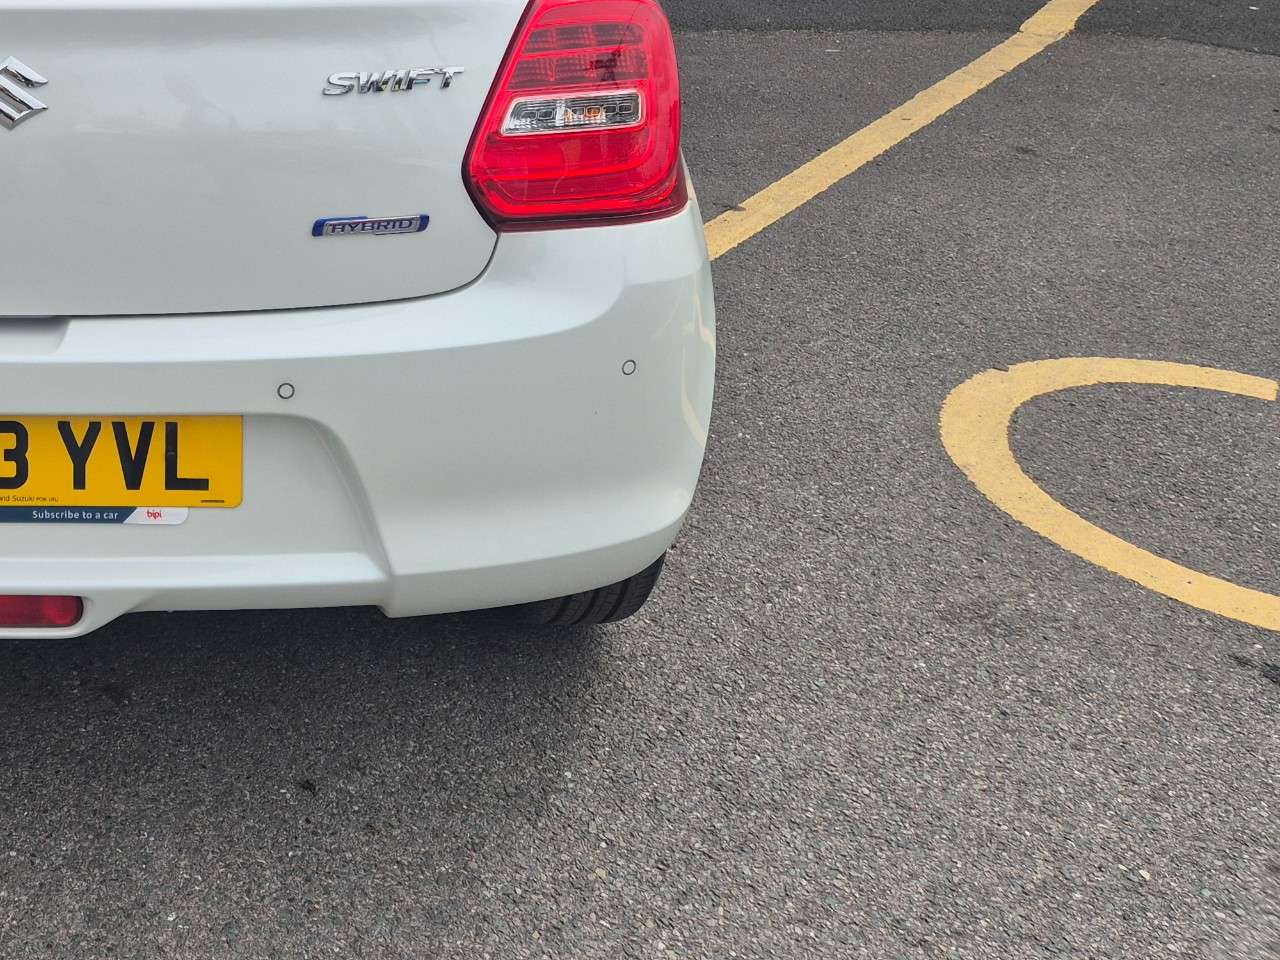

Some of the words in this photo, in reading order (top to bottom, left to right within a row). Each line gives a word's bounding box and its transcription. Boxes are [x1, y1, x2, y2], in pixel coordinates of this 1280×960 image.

[322, 66, 464, 96] SWIFT
[331, 219, 413, 234] HYBRID
[57, 421, 210, 491] YVL
[32, 510, 80, 520] Subscribe
[82, 511, 93, 520] to
[95, 512, 102, 520] a
[103, 512, 119, 520] car
[146, 509, 162, 520] bipi
